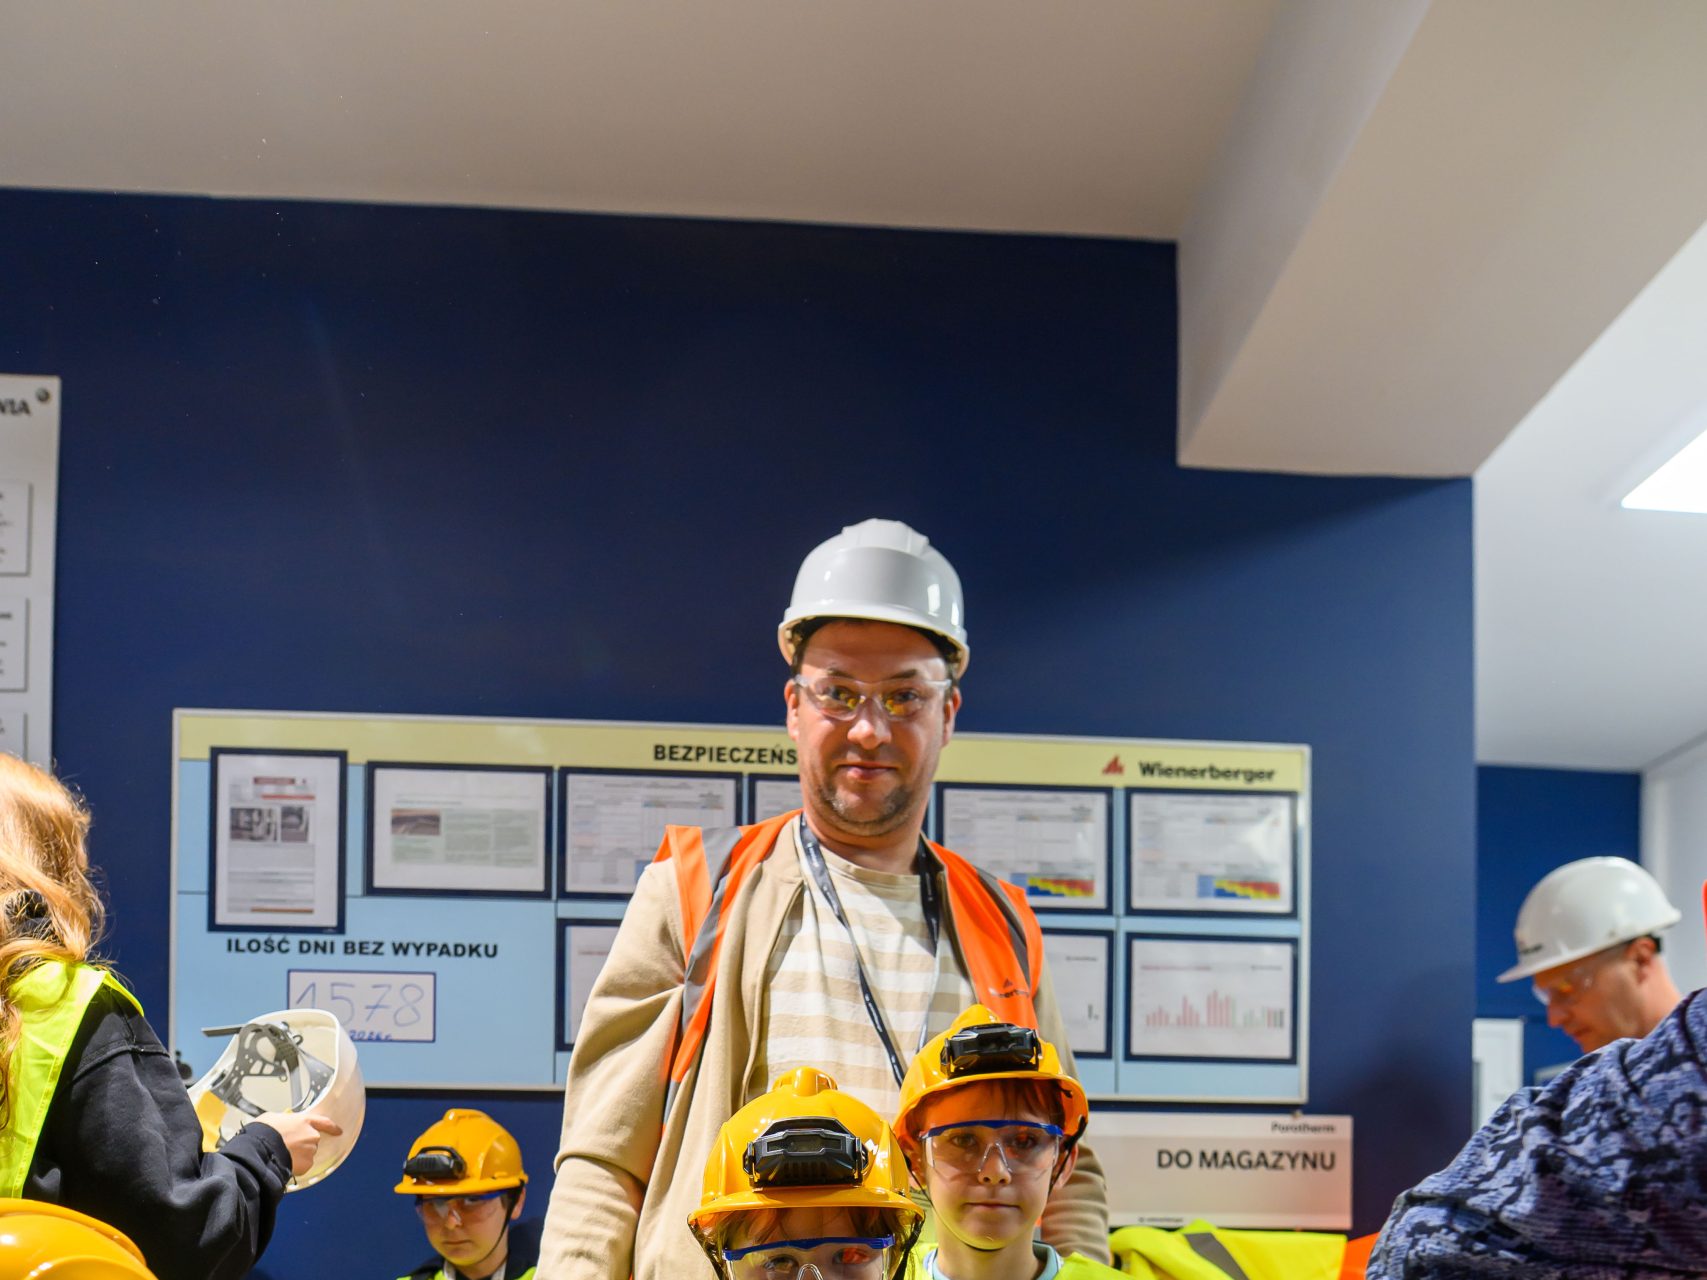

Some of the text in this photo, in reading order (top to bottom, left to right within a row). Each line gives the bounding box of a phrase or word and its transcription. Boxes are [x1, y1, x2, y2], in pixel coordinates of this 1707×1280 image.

[653, 743, 798, 765] BEZPIECZEŃS
[1139, 760, 1275, 784] Wienerberger
[226, 935, 498, 958] ILOŚĆ DNI BEZ WYPADKU
[296, 982, 424, 1027] 1578
[1271, 1121, 1336, 1134] Porotherm
[1157, 1149, 1336, 1171] DO MAGAZYNU
